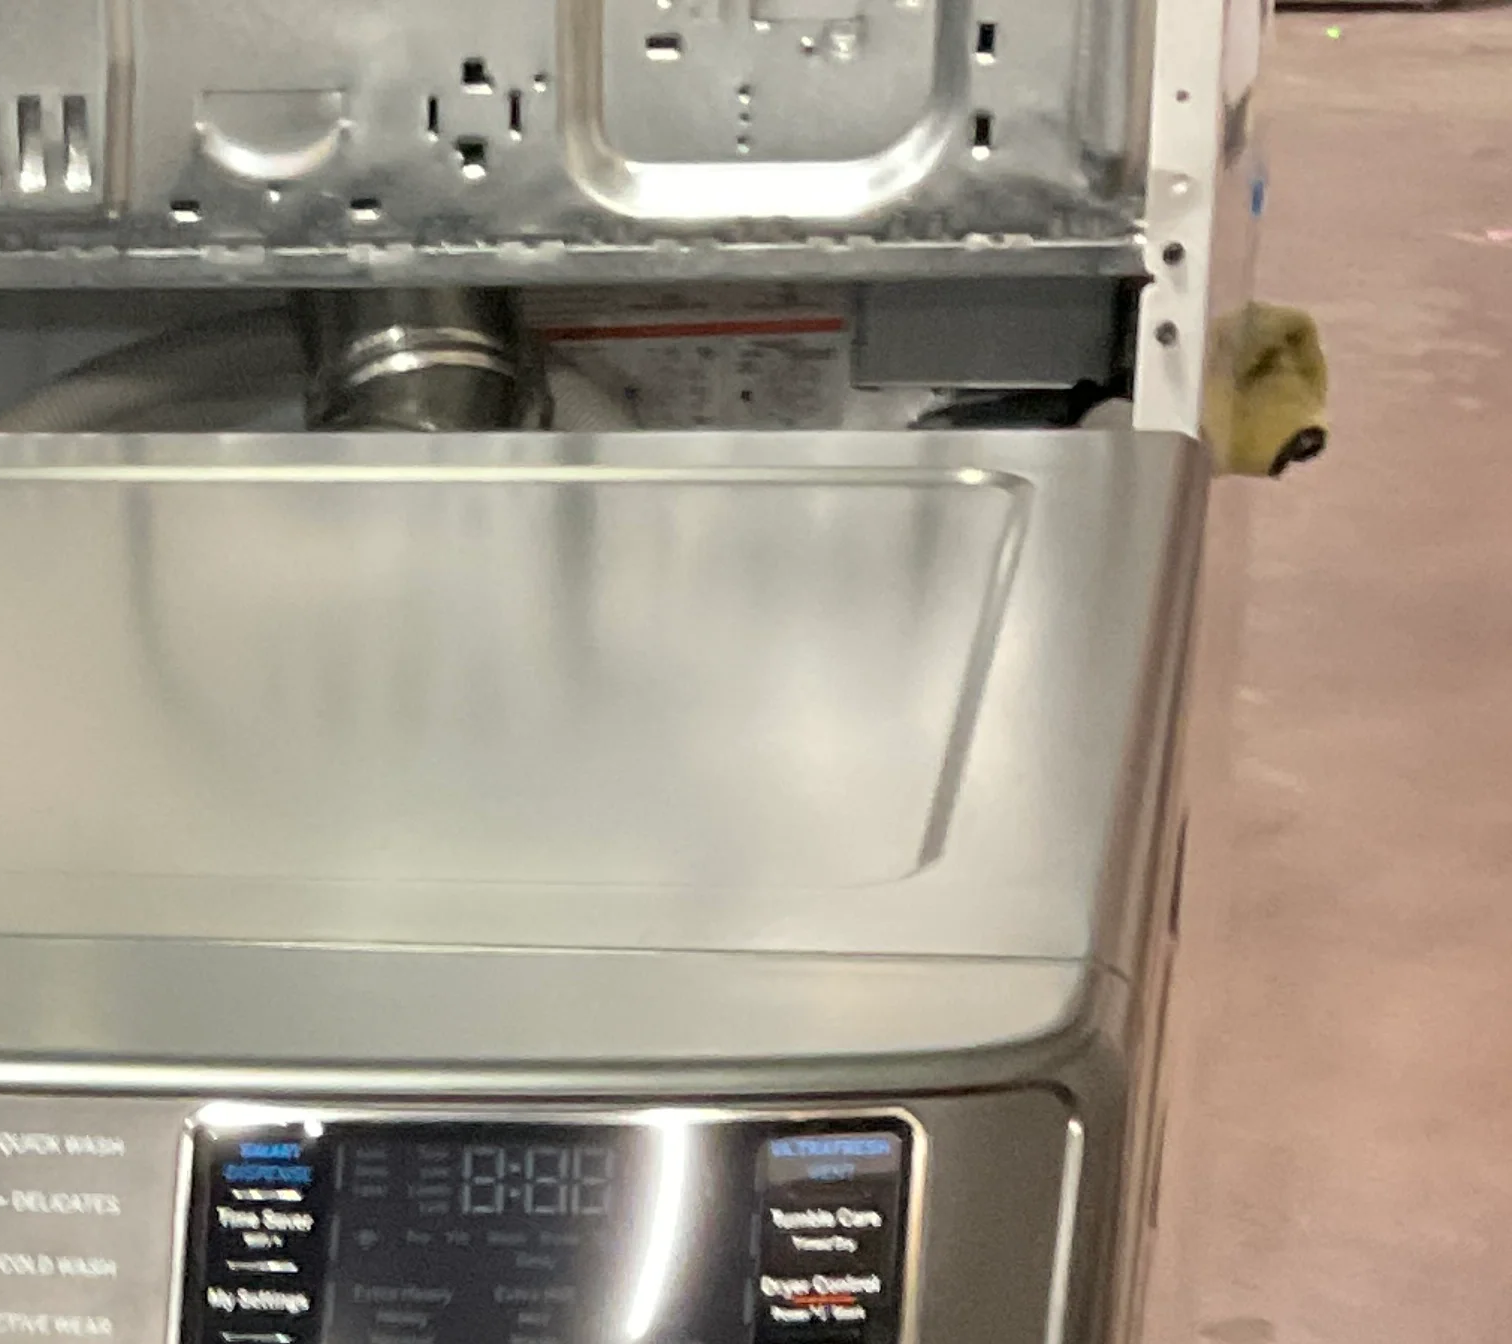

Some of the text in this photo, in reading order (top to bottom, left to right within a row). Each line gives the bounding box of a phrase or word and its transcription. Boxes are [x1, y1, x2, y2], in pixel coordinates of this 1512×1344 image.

[63, 1134, 126, 1157] WASH
[11, 1190, 121, 1216] DELICATES
[55, 1255, 117, 1279] WASH
[207, 1286, 311, 1314] My Settings
